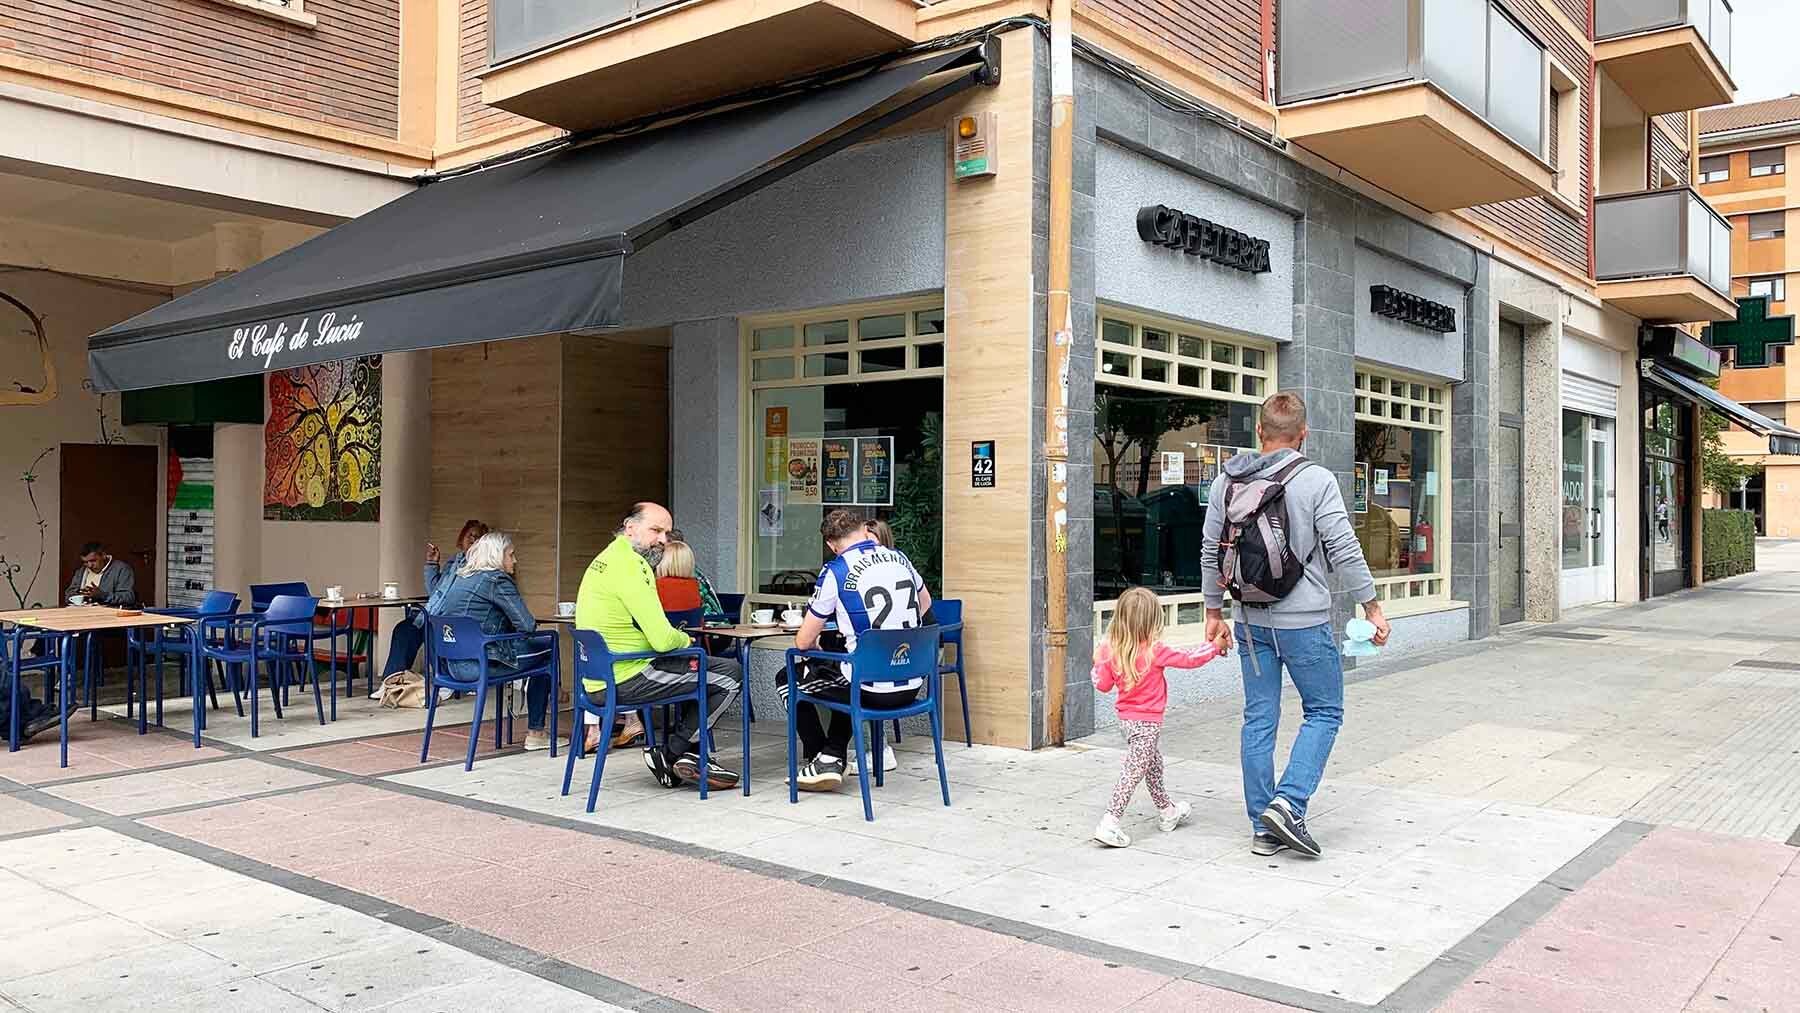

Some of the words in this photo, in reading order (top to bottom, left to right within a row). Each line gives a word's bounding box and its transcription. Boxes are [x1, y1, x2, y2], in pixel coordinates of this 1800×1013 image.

[228, 327, 250, 360] El
[251, 322, 288, 369] Café
[288, 317, 309, 351] de
[312, 311, 364, 347] Lucía
[974, 459, 993, 474] 42
[844, 556, 873, 592] BRAIS
[864, 579, 922, 630] 23
